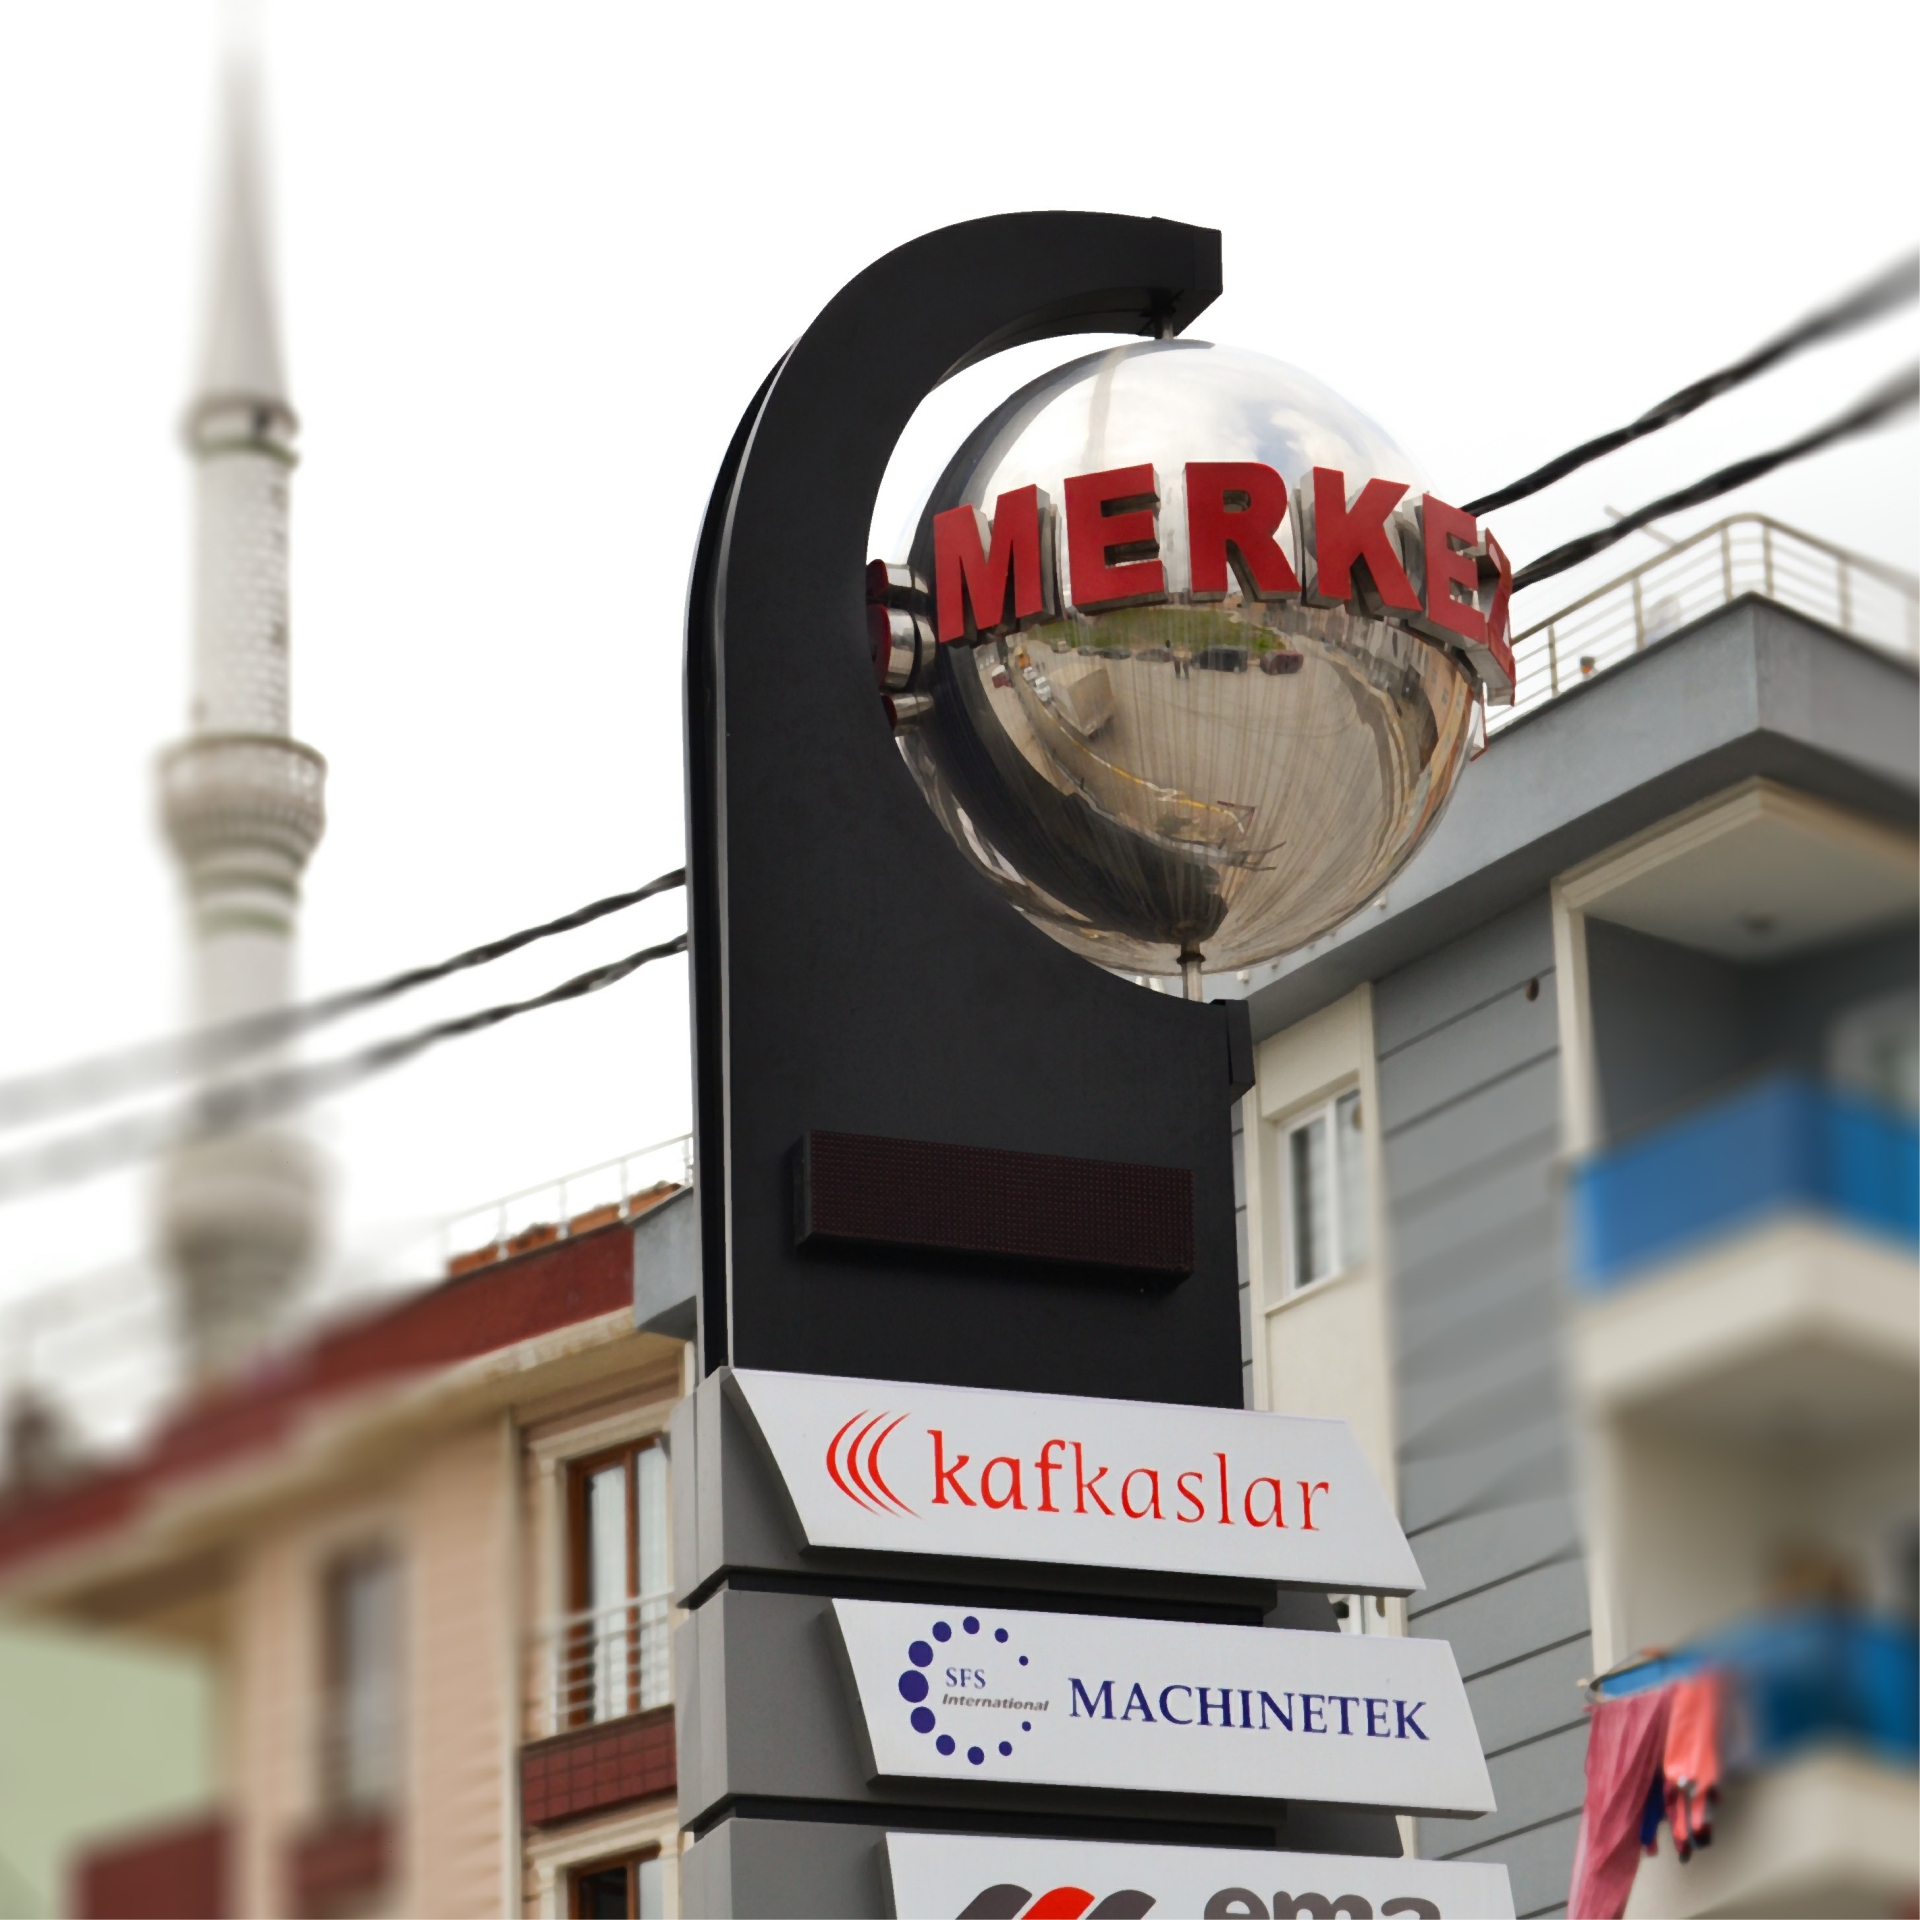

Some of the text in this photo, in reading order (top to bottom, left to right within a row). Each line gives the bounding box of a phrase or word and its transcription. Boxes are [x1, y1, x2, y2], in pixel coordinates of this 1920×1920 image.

[927, 1428, 1330, 1531] kafkaslar
[945, 1667, 986, 1690] SFS
[942, 1693, 1050, 1712] International
[1068, 1677, 1430, 1741] MACHINETEK
